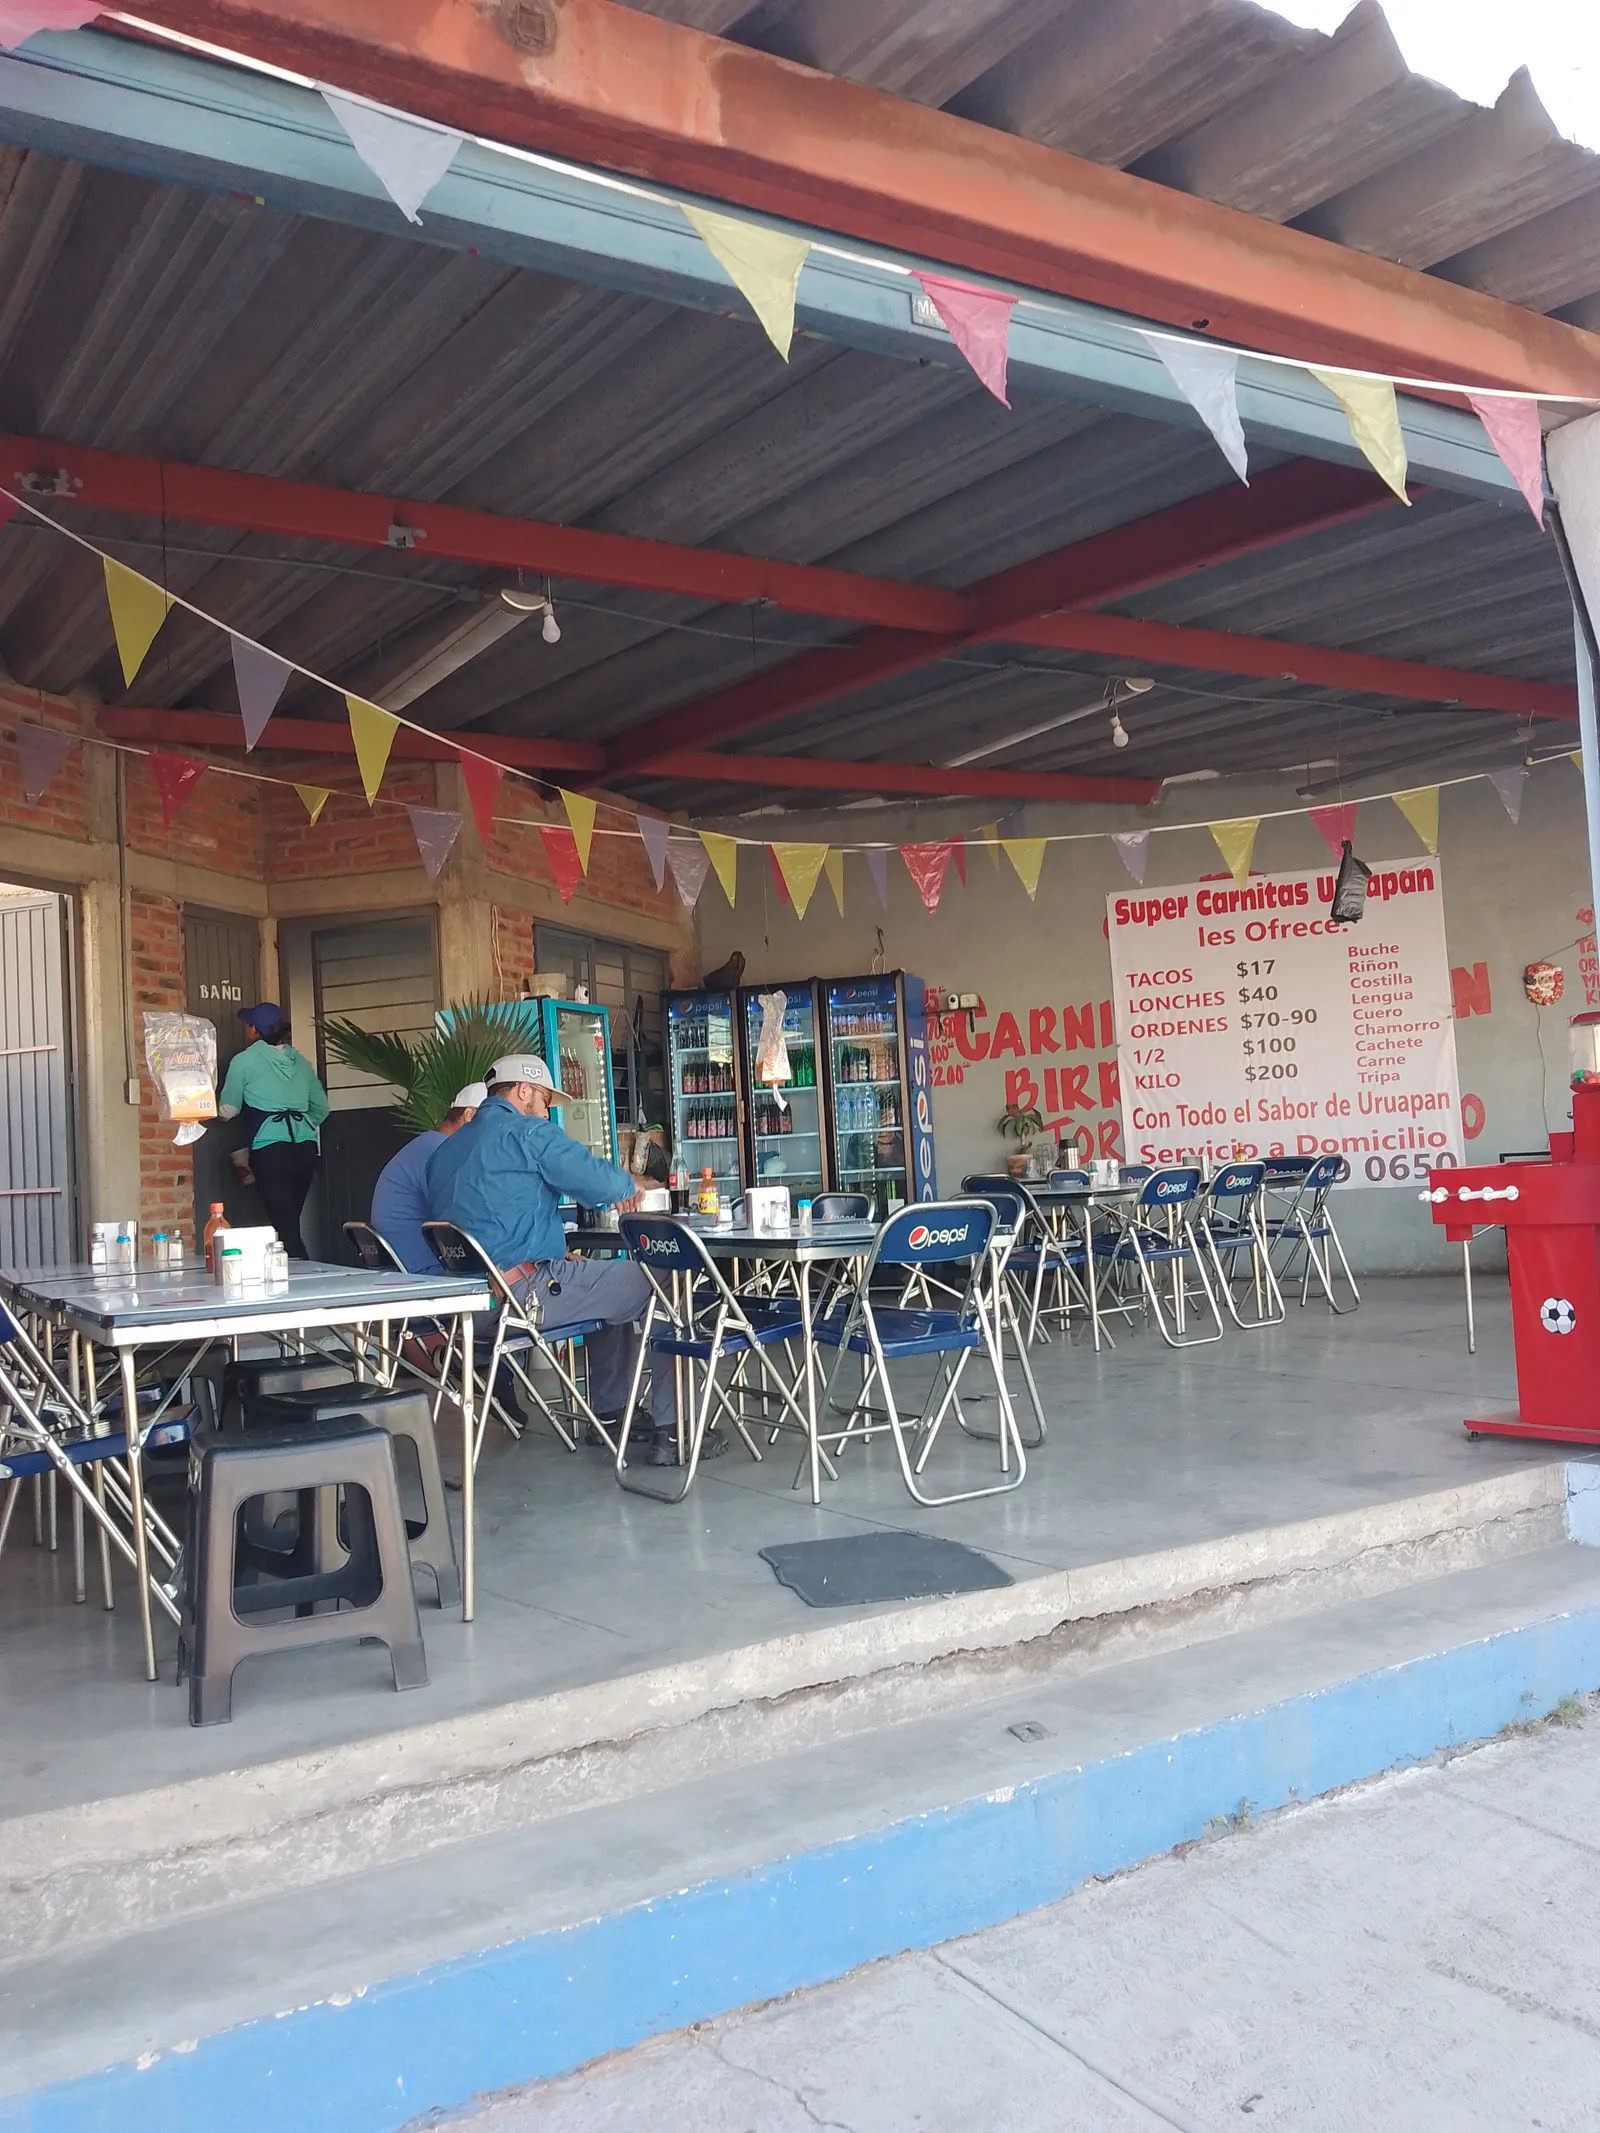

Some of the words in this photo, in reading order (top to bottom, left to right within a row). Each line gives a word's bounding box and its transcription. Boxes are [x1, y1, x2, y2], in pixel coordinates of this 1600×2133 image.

[1115, 895, 1188, 927] Super
[1196, 881, 1309, 916] Carnitas
[1316, 867, 1434, 902] Uapan
[1198, 927, 1236, 948] les
[1348, 943, 1400, 958] Buche
[1126, 968, 1193, 988] TACOS
[1236, 959, 1276, 979] $17
[1349, 960, 1399, 973] Riñon
[199, 980, 242, 1001] BAÑO
[1350, 973, 1413, 989] Costilla
[857, 988, 879, 998] pepsi
[1129, 991, 1226, 1013] LONCHES
[1238, 986, 1278, 1005] $40
[1352, 991, 1413, 1005] Lengua
[695, 1001, 723, 1014] pepsi
[1353, 1008, 1403, 1020] Cuero
[954, 995, 1113, 1062] CARNI
[1130, 1016, 1229, 1039] ORDENES
[1240, 1008, 1318, 1031] $70-90
[1354, 1021, 1440, 1036] Chamorro
[1133, 1048, 1166, 1066] 1/2
[1242, 1037, 1296, 1057] $100
[1355, 1037, 1424, 1052] Cachete
[1357, 1055, 1406, 1068] Carne
[1135, 1073, 1181, 1090] KILO
[1245, 1063, 1298, 1084] $200
[1358, 1071, 1401, 1086] Tripa
[1005, 1060, 1120, 1116] BIRR
[1132, 1107, 1170, 1130] Con
[1176, 1101, 1227, 1127] Todo
[1233, 1099, 1251, 1123] el
[1257, 1096, 1318, 1122] Sabor
[1325, 1092, 1351, 1117] de
[1357, 1091, 1451, 1119] Uruapan
[1140, 1138, 1258, 1165] Servicio
[1268, 1141, 1285, 1158] a
[1296, 1126, 1447, 1156] Domicilio
[1364, 1152, 1459, 1182] 0650
[1167, 1181, 1188, 1196] pepsi
[1234, 1175, 1254, 1189] pepsi
[927, 1224, 969, 1248] pepsi
[650, 1237, 681, 1256] pepsi
